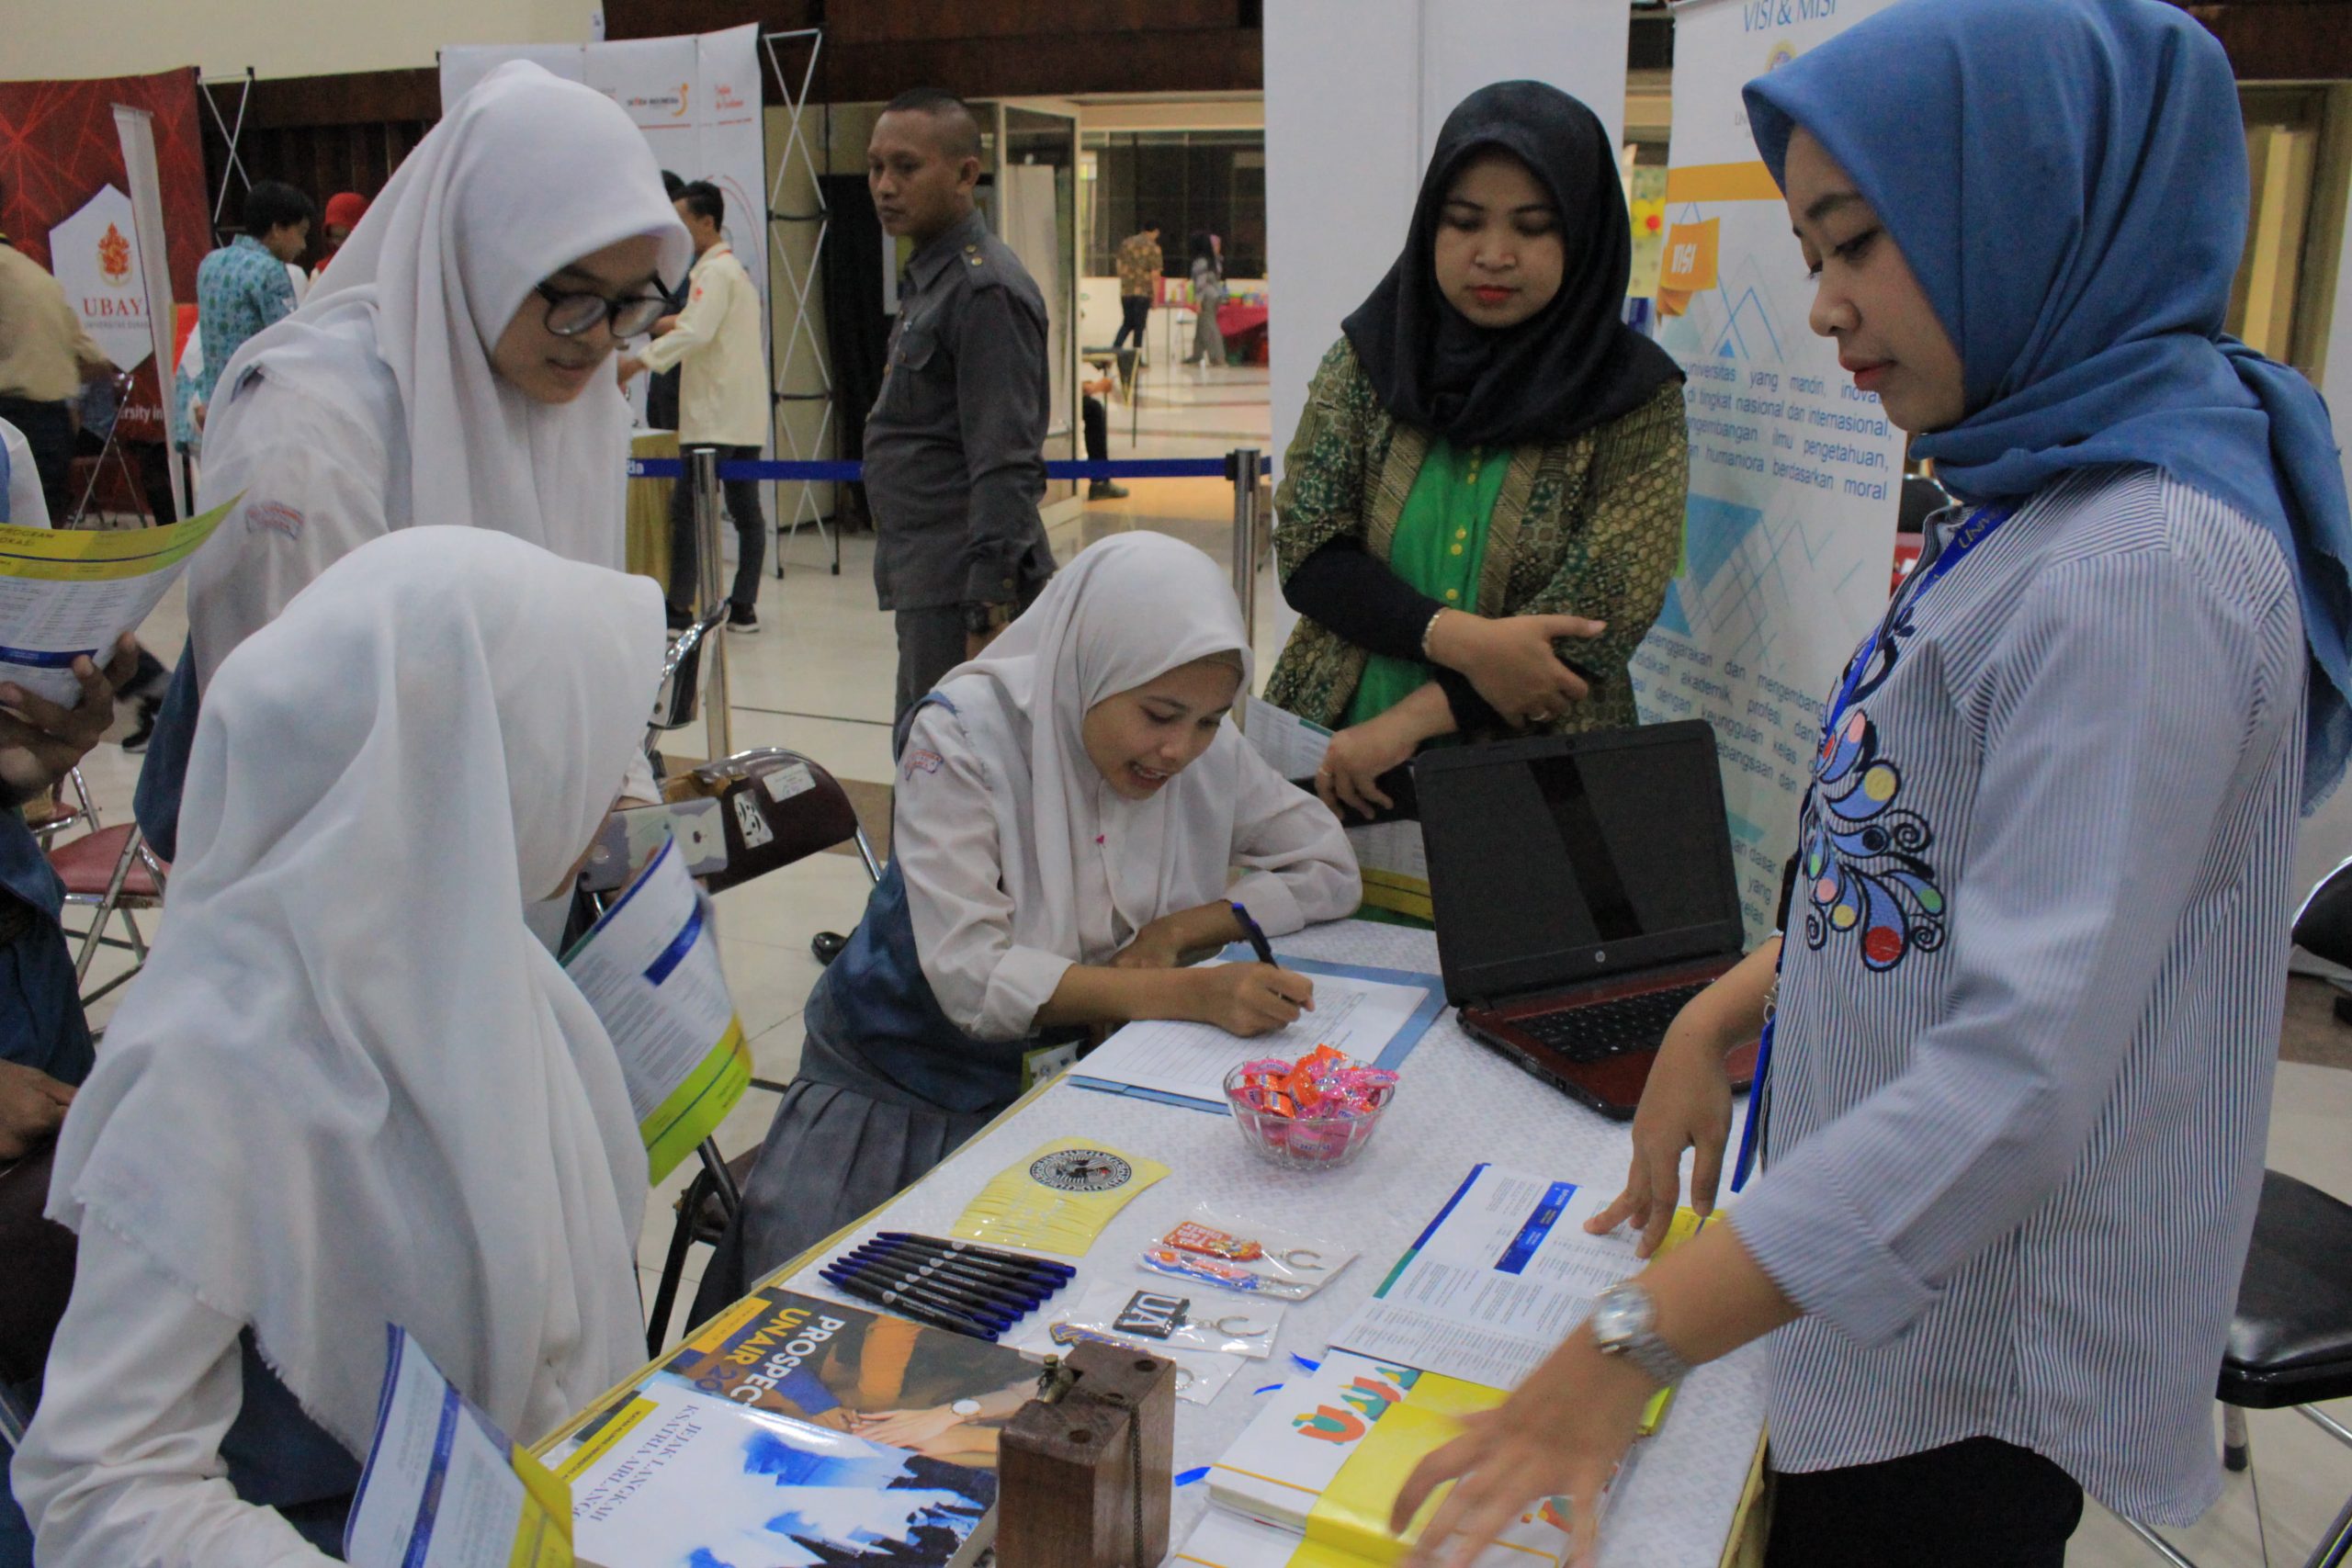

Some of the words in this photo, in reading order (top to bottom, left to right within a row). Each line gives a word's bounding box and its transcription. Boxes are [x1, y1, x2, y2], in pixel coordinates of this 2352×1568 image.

[1744, 0, 1773, 32] VISI
[1777, 0, 1792, 26] &
[83, 298, 148, 317] UBAY
[1750, 369, 1779, 393] yang
[1700, 389, 1732, 412] tingkat
[1736, 396, 1784, 418] nasional
[1787, 403, 1805, 423] dan
[1807, 409, 1893, 441] internasional,
[1705, 446, 1764, 473] humaniora
[1772, 458, 1834, 491] berdasarkan
[1843, 477, 1887, 502] moral
[1771, 427, 1793, 450] ilmu
[1804, 437, 1889, 473] pengetahuan,
[1680, 670, 1735, 707] akademik,
[1724, 660, 1746, 681] dan
[1757, 672, 1826, 723] mengembang
[1655, 685, 1691, 715] dengan
[1701, 703, 1764, 746] keunggulan
[1772, 736, 1797, 766] kelas
[1715, 740, 1774, 779] ebangsaan
[1778, 772, 1797, 794] dan
[1747, 875, 1772, 906] yang
[723, 1307, 812, 1366] UNAIR
[729, 1314, 846, 1403] PROSPEC
[637, 1404, 700, 1455] KSATRIA
[659, 1422, 702, 1459] JEJAK
[589, 1459, 664, 1522] LANGKAH
